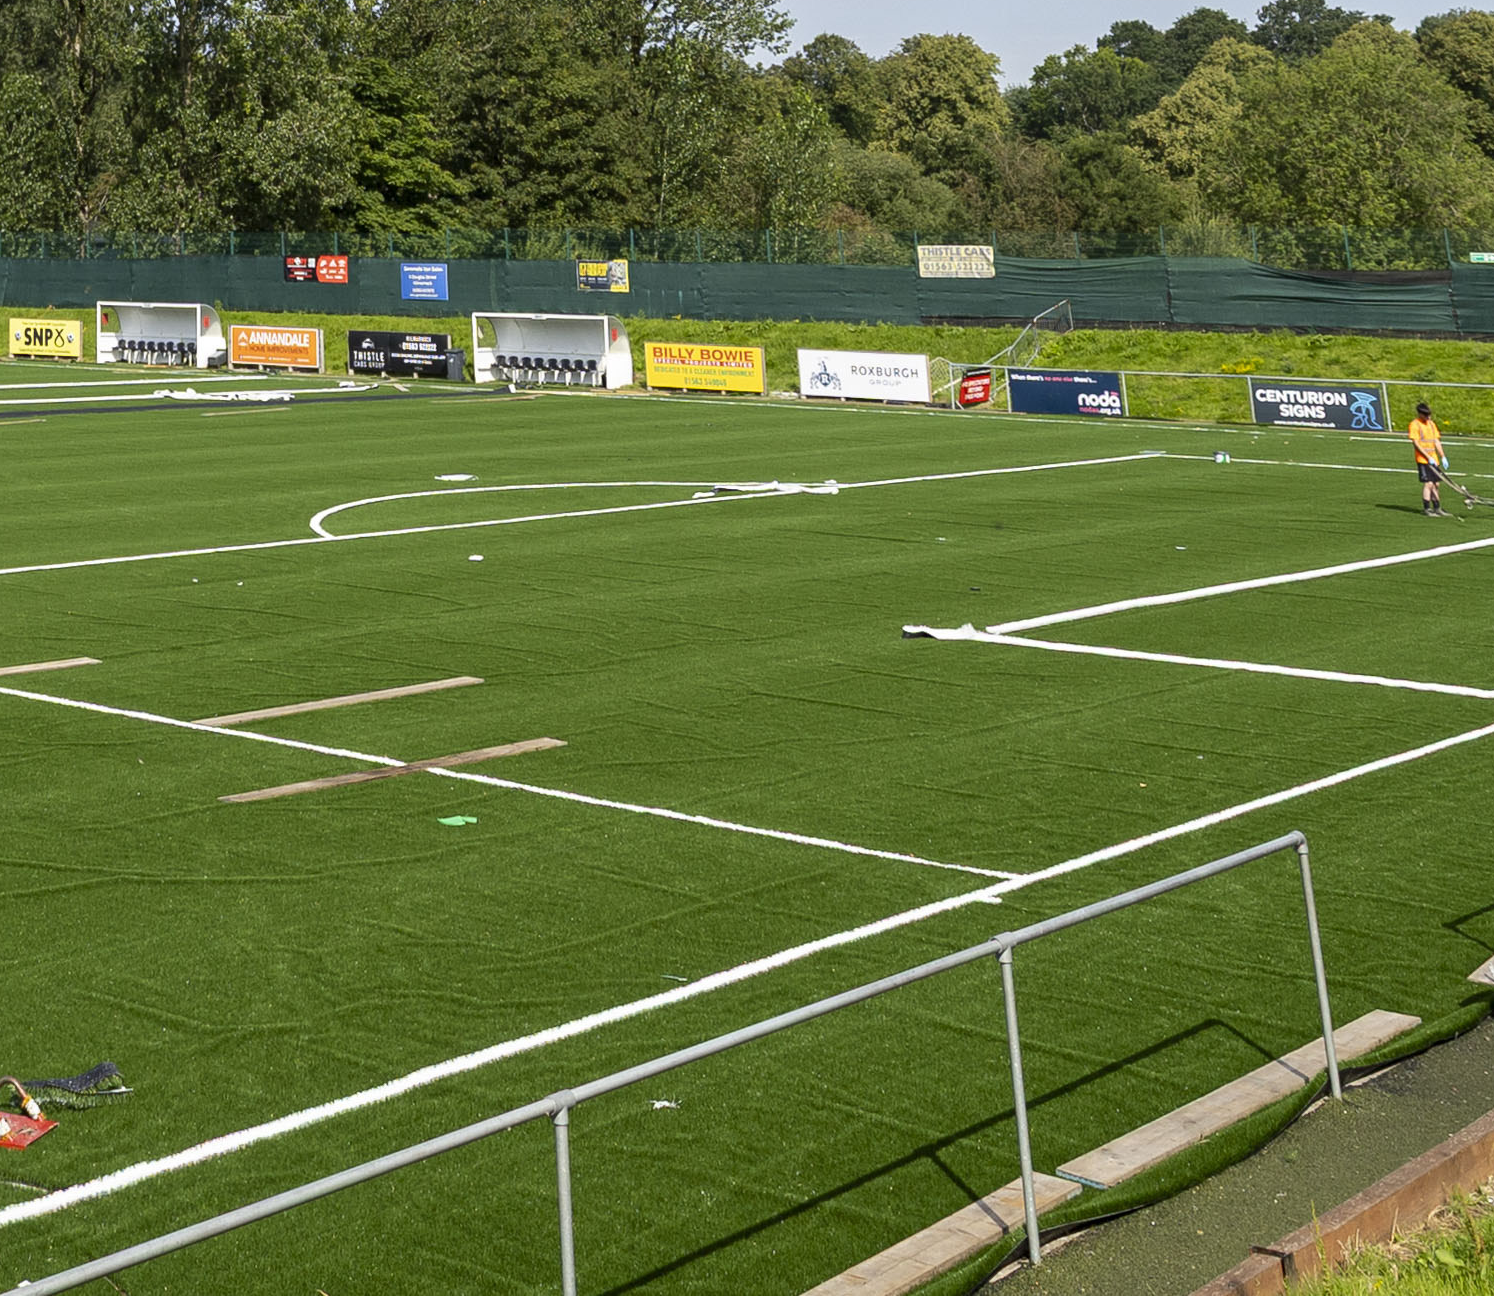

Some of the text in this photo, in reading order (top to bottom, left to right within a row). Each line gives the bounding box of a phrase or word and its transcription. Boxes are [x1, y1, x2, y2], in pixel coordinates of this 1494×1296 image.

[921, 248, 961, 256] THISTLE
[924, 263, 952, 271] 01563
[24, 327, 53, 347] SNP
[249, 331, 310, 348] ANNANDALE
[353, 351, 385, 362] THISTLE
[653, 347, 754, 362] BILLY BOWIE
[851, 365, 919, 378] ROXBURGH
[1255, 389, 1348, 406] CENTURION
[1279, 404, 1326, 419] SIGNS
